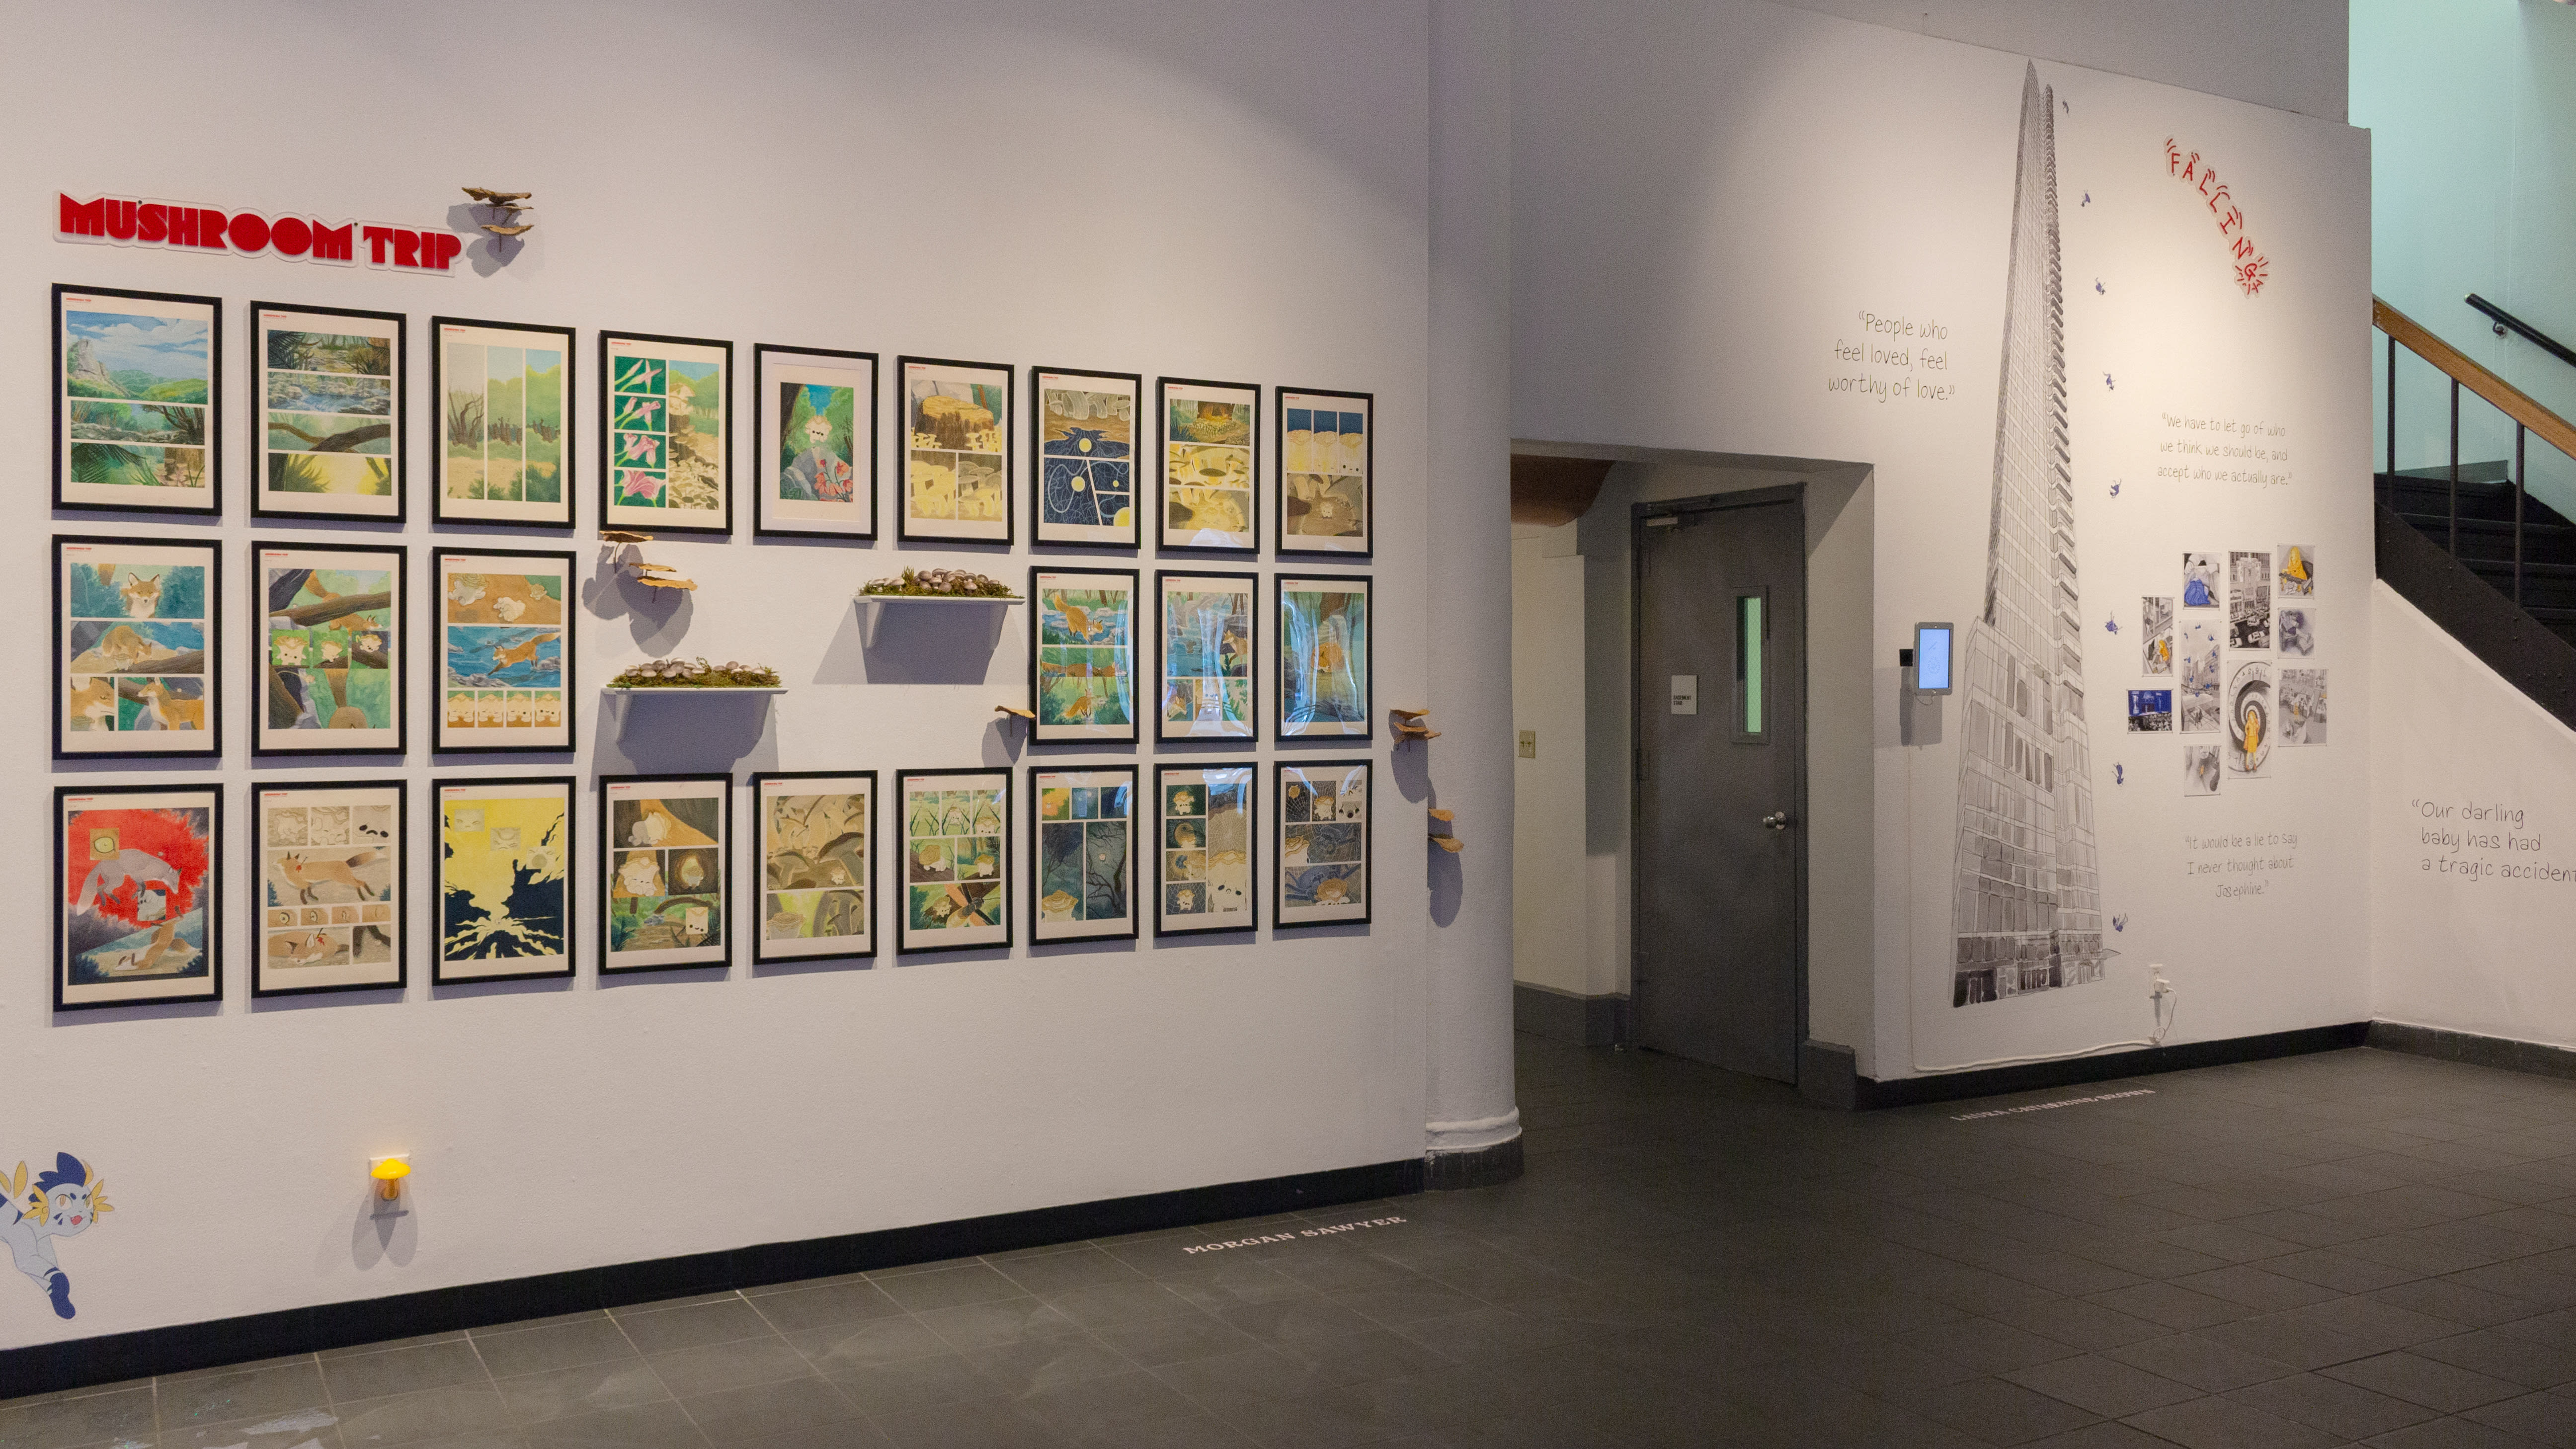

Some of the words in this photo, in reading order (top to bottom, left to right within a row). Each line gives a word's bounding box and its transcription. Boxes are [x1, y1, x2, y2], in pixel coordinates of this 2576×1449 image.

[2171, 153, 2257, 281] FALLING
[59, 192, 353, 261] MUSHROOM
[362, 225, 462, 270] TRIP
[1920, 319, 1948, 340] who
[1835, 338, 1864, 362] feel
[1871, 343, 1913, 372] loved,
[1920, 348, 1947, 370] feel
[1829, 373, 1887, 403] worthy
[1893, 377, 1911, 397] of
[2184, 416, 2206, 430] have
[2210, 417, 2221, 431] to
[2224, 418, 2236, 433] let
[2241, 423, 2251, 439] go
[2254, 421, 2264, 435] of
[2267, 423, 2286, 437] who
[2160, 441, 2174, 453] we
[2177, 439, 2202, 455] think
[2206, 445, 2220, 456] we
[2223, 444, 2252, 459] should
[2255, 448, 2268, 463] be,
[2271, 448, 2288, 461] and
[2158, 465, 2189, 483] accept
[2193, 467, 2212, 480] who
[2215, 471, 2228, 481] we
[2231, 469, 2267, 489] actually
[2462, 801, 2524, 829] darling
[2202, 836, 2228, 849] would
[2232, 835, 2243, 847] be
[2246, 838, 2251, 846] a
[2254, 833, 2264, 846] lie
[2268, 832, 2278, 845] to
[2282, 833, 2297, 849] say
[2421, 827, 2460, 854] baby
[2468, 830, 2500, 849] has
[2509, 832, 2541, 852] had
[2187, 862, 2194, 875] I
[2198, 863, 2222, 874] never
[2227, 857, 2264, 876] thought
[2268, 855, 2293, 869] about
[2421, 859, 2430, 871] a
[2439, 855, 2494, 882] tragic
[1182, 1232, 1296, 1254] MORGAN
[1300, 1216, 1408, 1237] SAWYER
